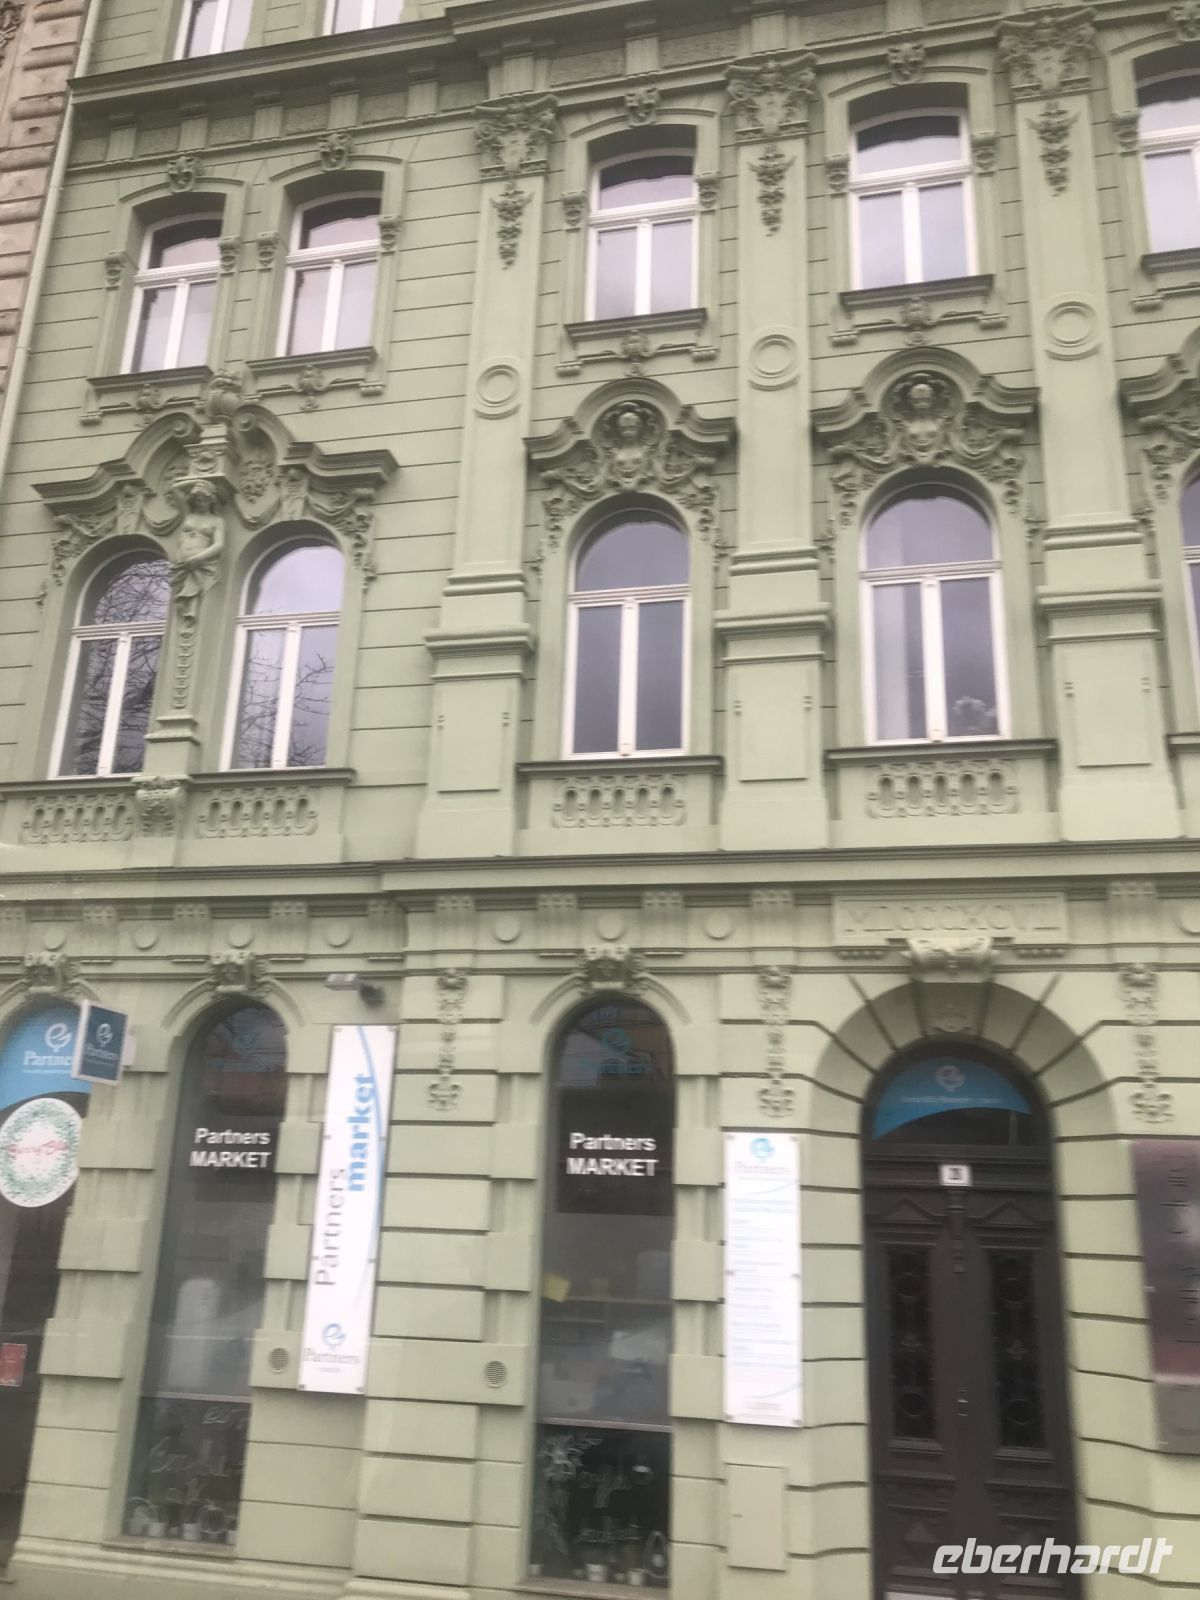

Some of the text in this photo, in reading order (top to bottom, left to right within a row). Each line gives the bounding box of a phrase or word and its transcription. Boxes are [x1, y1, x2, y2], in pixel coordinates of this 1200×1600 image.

[194, 1127, 271, 1145] Partners
[346, 1073, 375, 1192] market
[568, 1132, 657, 1151] Partners
[189, 1150, 272, 1169] MARKET
[566, 1157, 660, 1177] MARKET
[313, 1168, 348, 1286] Partners
